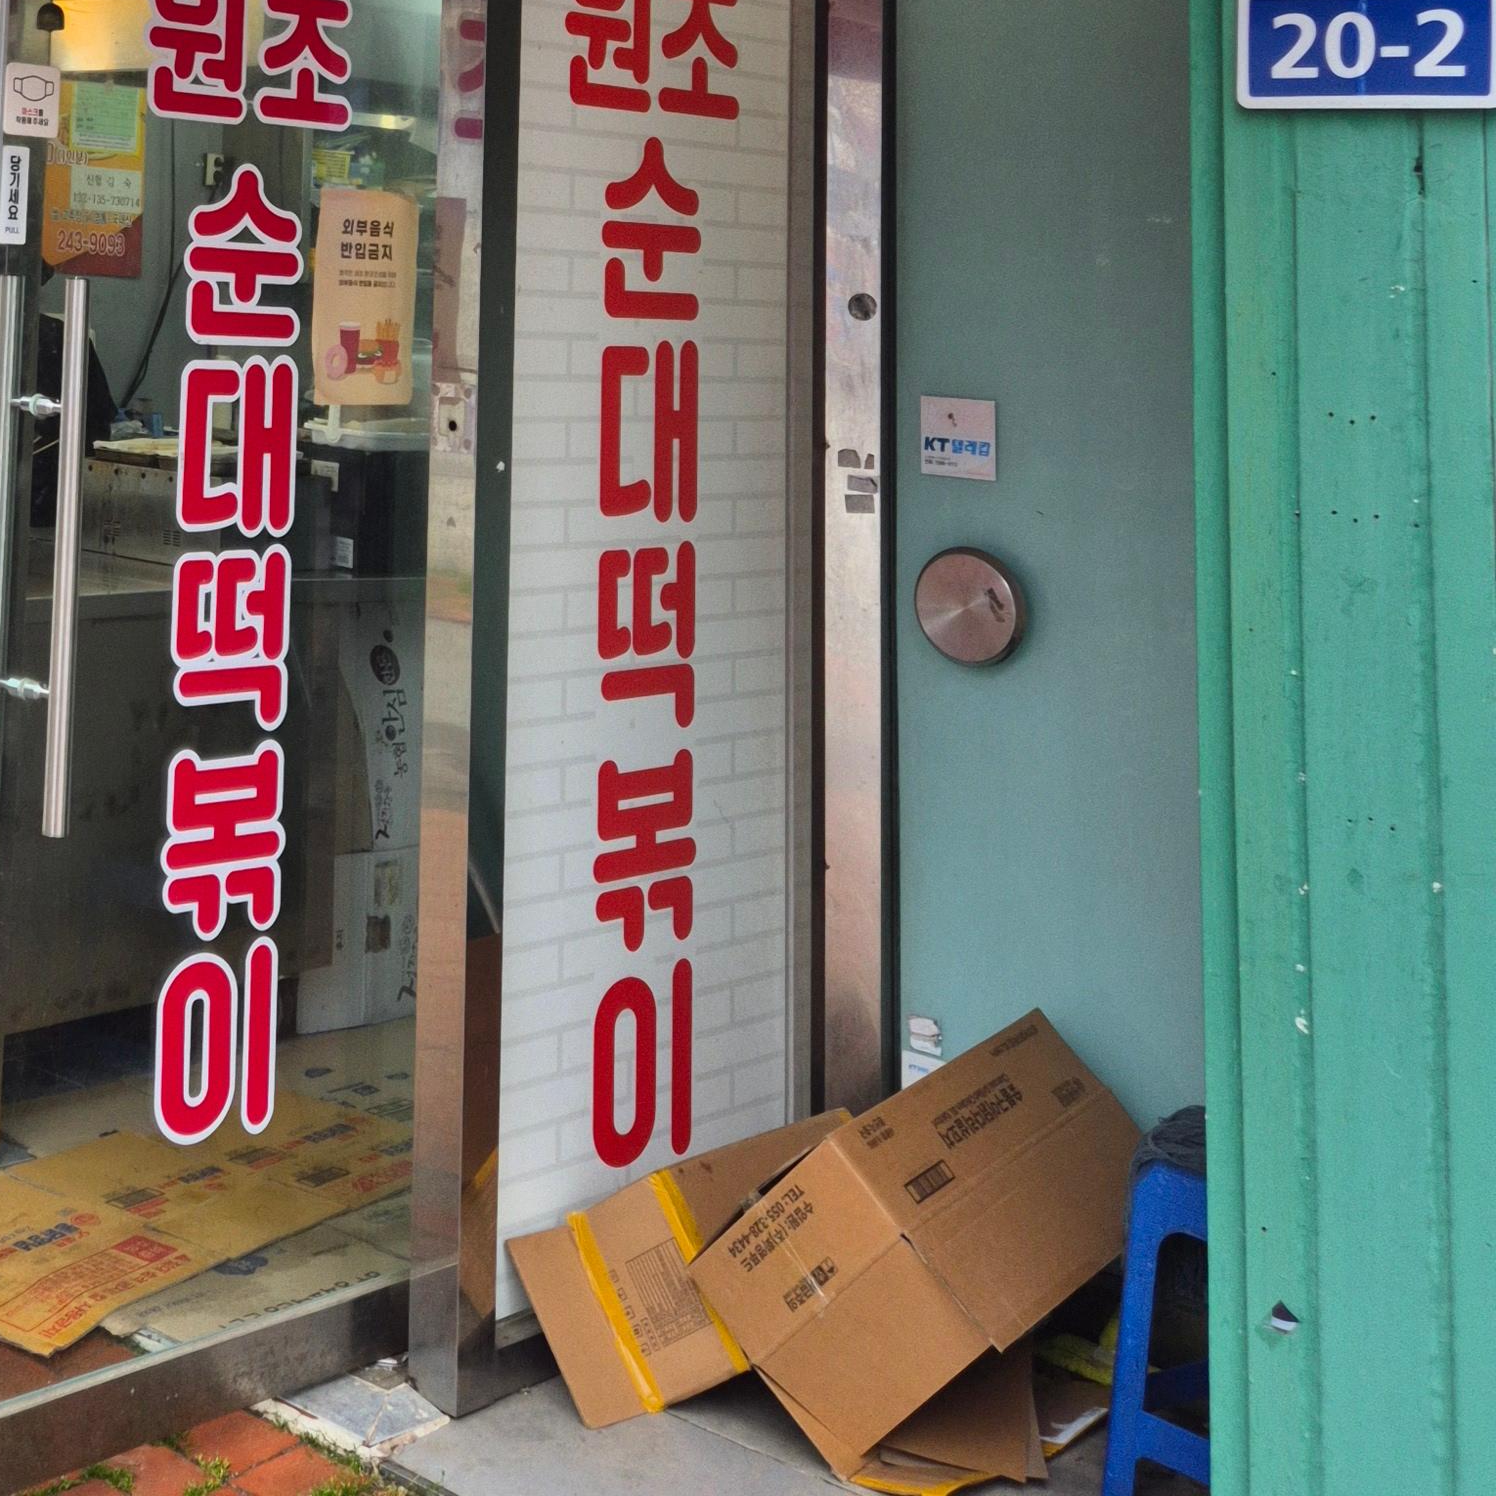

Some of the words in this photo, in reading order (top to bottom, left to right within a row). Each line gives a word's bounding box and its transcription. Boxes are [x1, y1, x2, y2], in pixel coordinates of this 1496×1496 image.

[1270, 8, 1467, 80] 20-2
[8, 154, 22, 221] 당기세요
[4, 225, 20, 235] PULL
[341, 217, 395, 238] 외부음식
[57, 229, 127, 255] 243-9093
[340, 241, 394, 262] 반입금지
[924, 436, 950, 453] KT
[781, 1184, 805, 1206] TEL:
